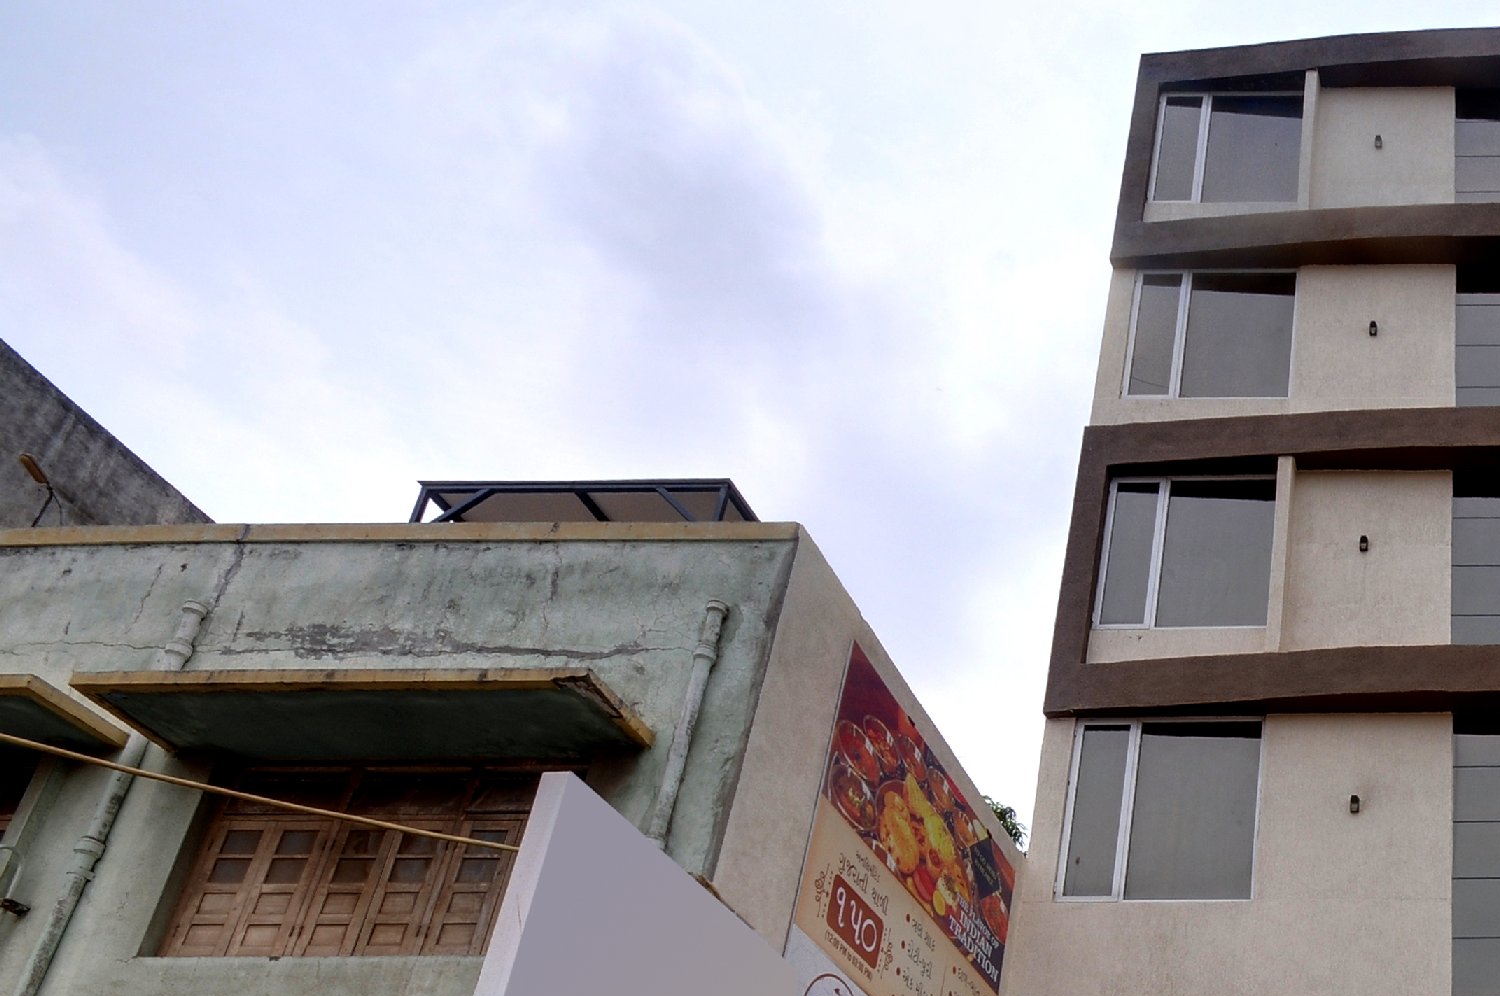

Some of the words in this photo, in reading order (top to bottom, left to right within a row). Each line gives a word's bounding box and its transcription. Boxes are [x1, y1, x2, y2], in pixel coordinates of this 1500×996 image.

[839, 852, 869, 894] ગુજરાતી
[872, 887, 889, 916] થાળી
[836, 886, 878, 953] ૧૫૦
[949, 914, 999, 983] TRADITION
[959, 911, 993, 958] INDIAN
